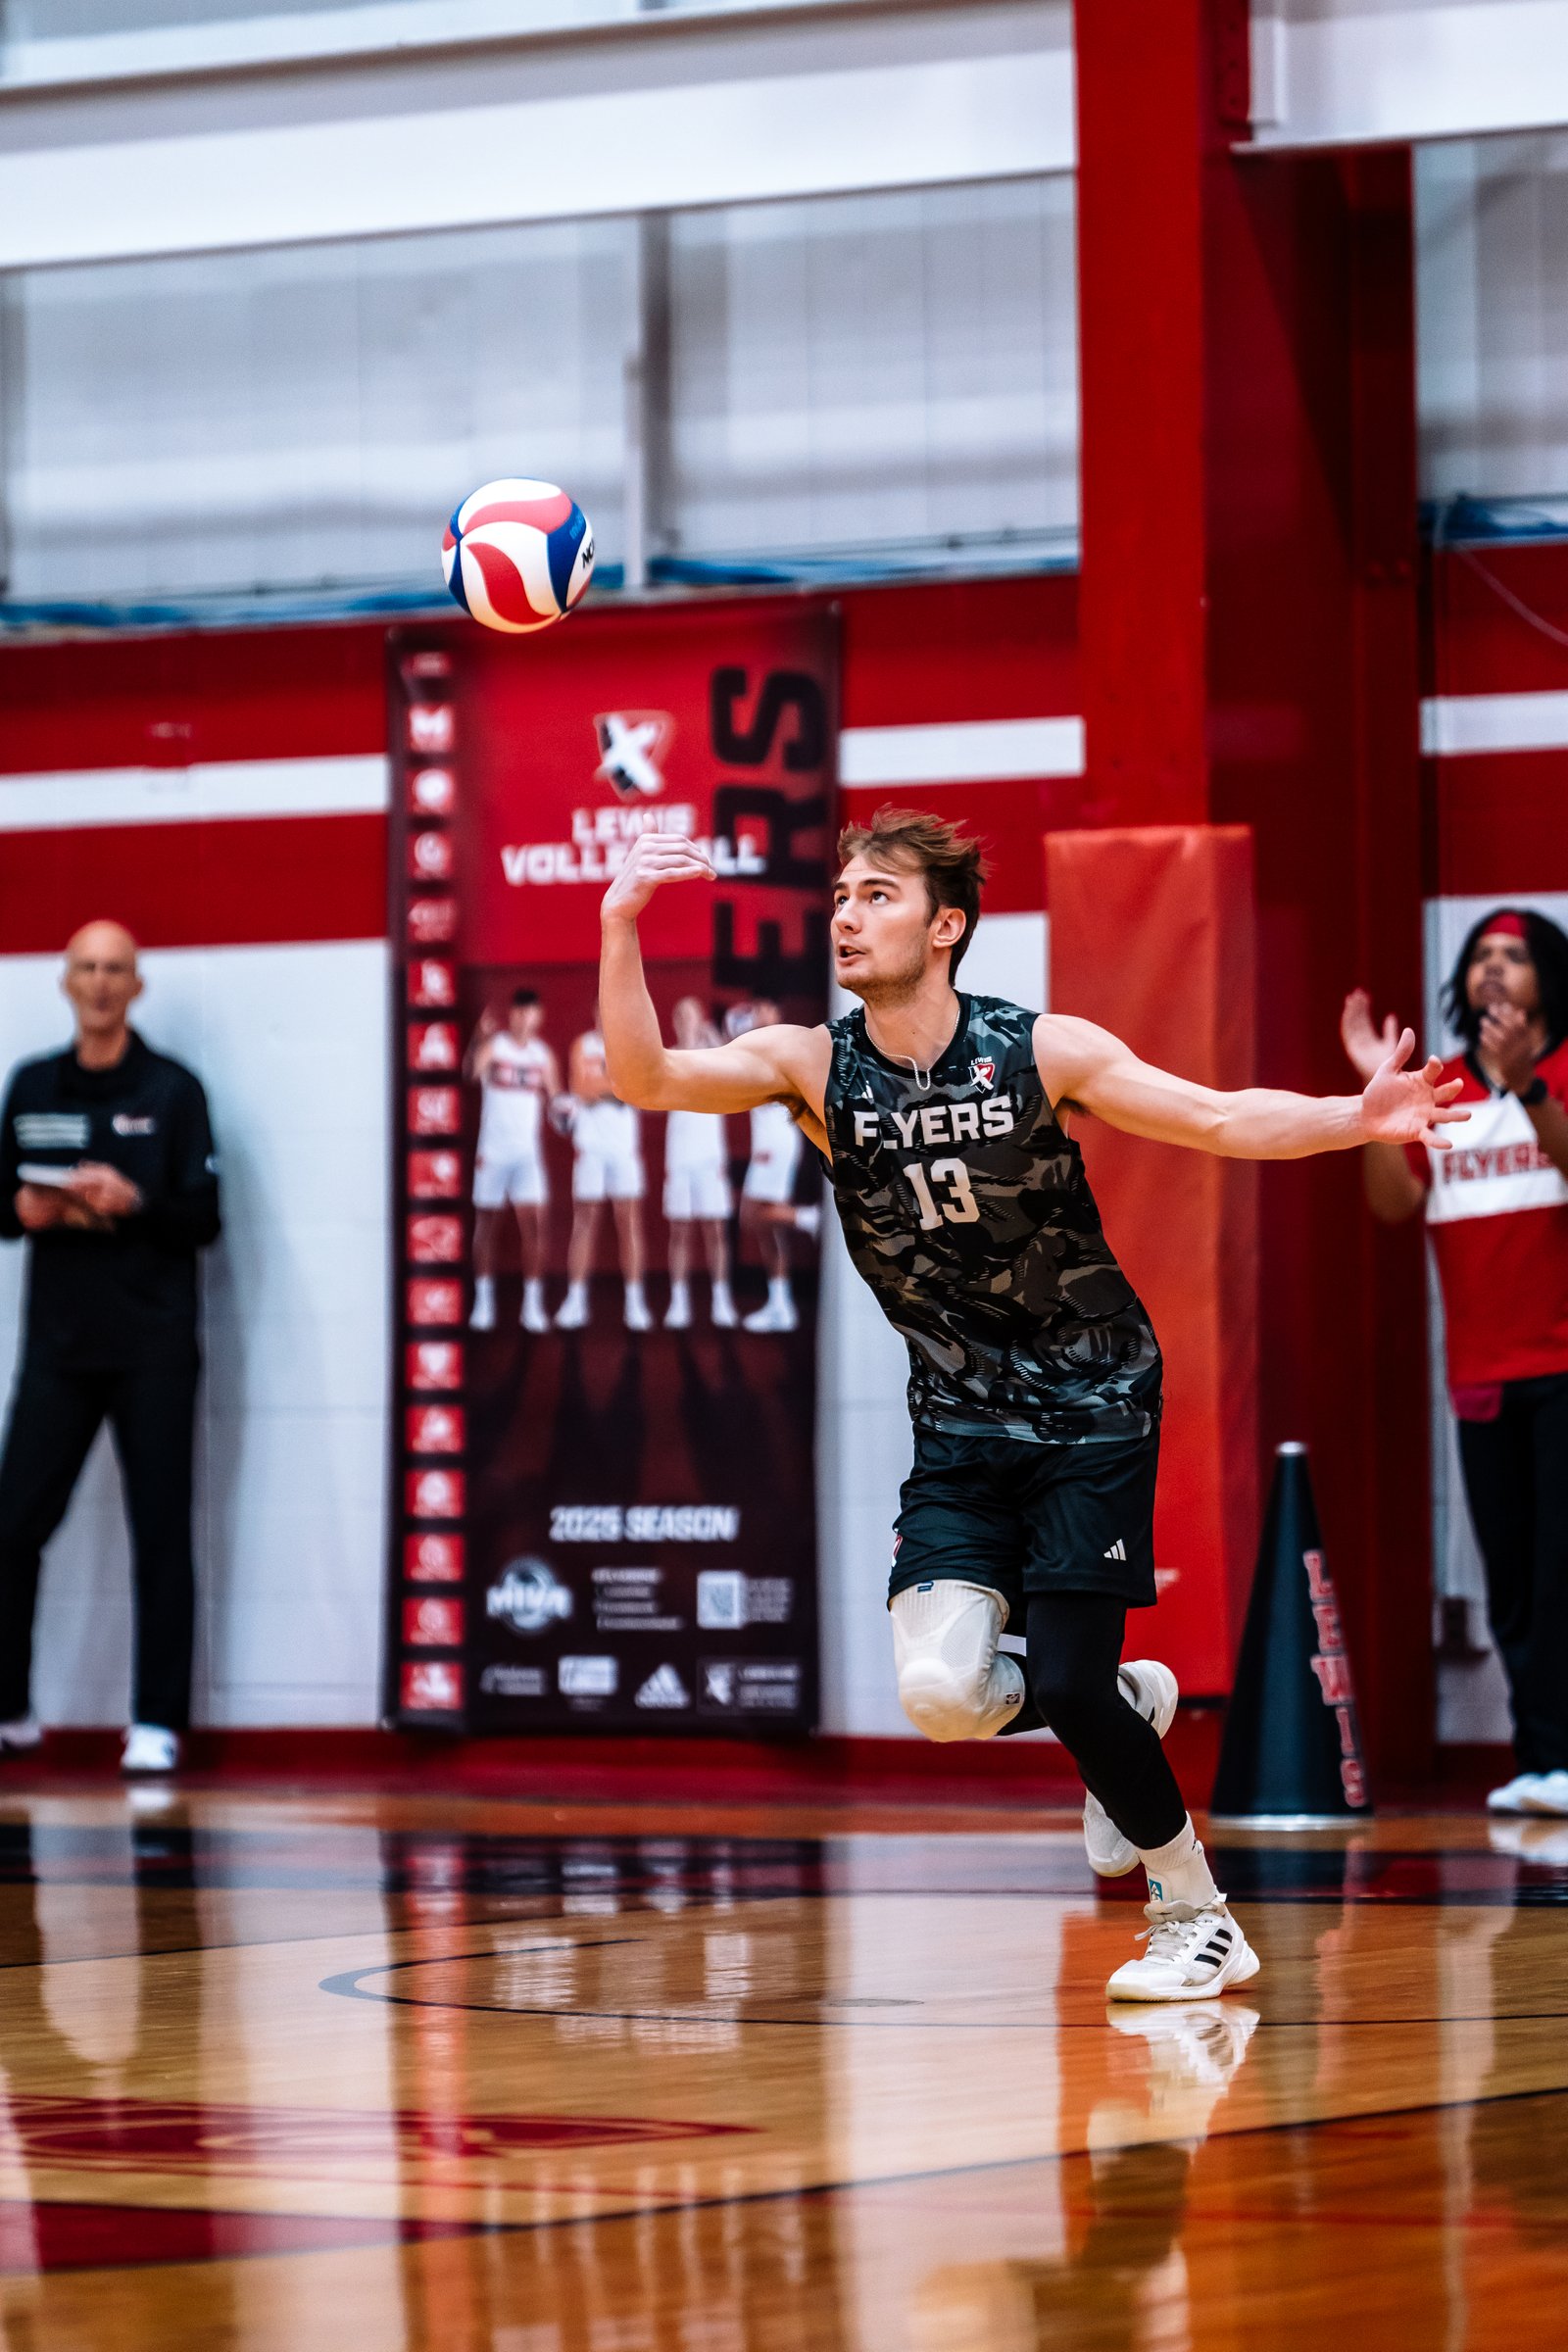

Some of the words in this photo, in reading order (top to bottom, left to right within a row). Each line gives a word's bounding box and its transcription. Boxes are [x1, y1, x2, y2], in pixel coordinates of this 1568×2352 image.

[571, 804, 695, 845] LEWIS
[710, 665, 829, 1024] ERS
[501, 835, 767, 885] VOLLELL
[903, 1157, 980, 1231] 13
[550, 1505, 621, 1543] 2025
[624, 1505, 740, 1543] SEASON
